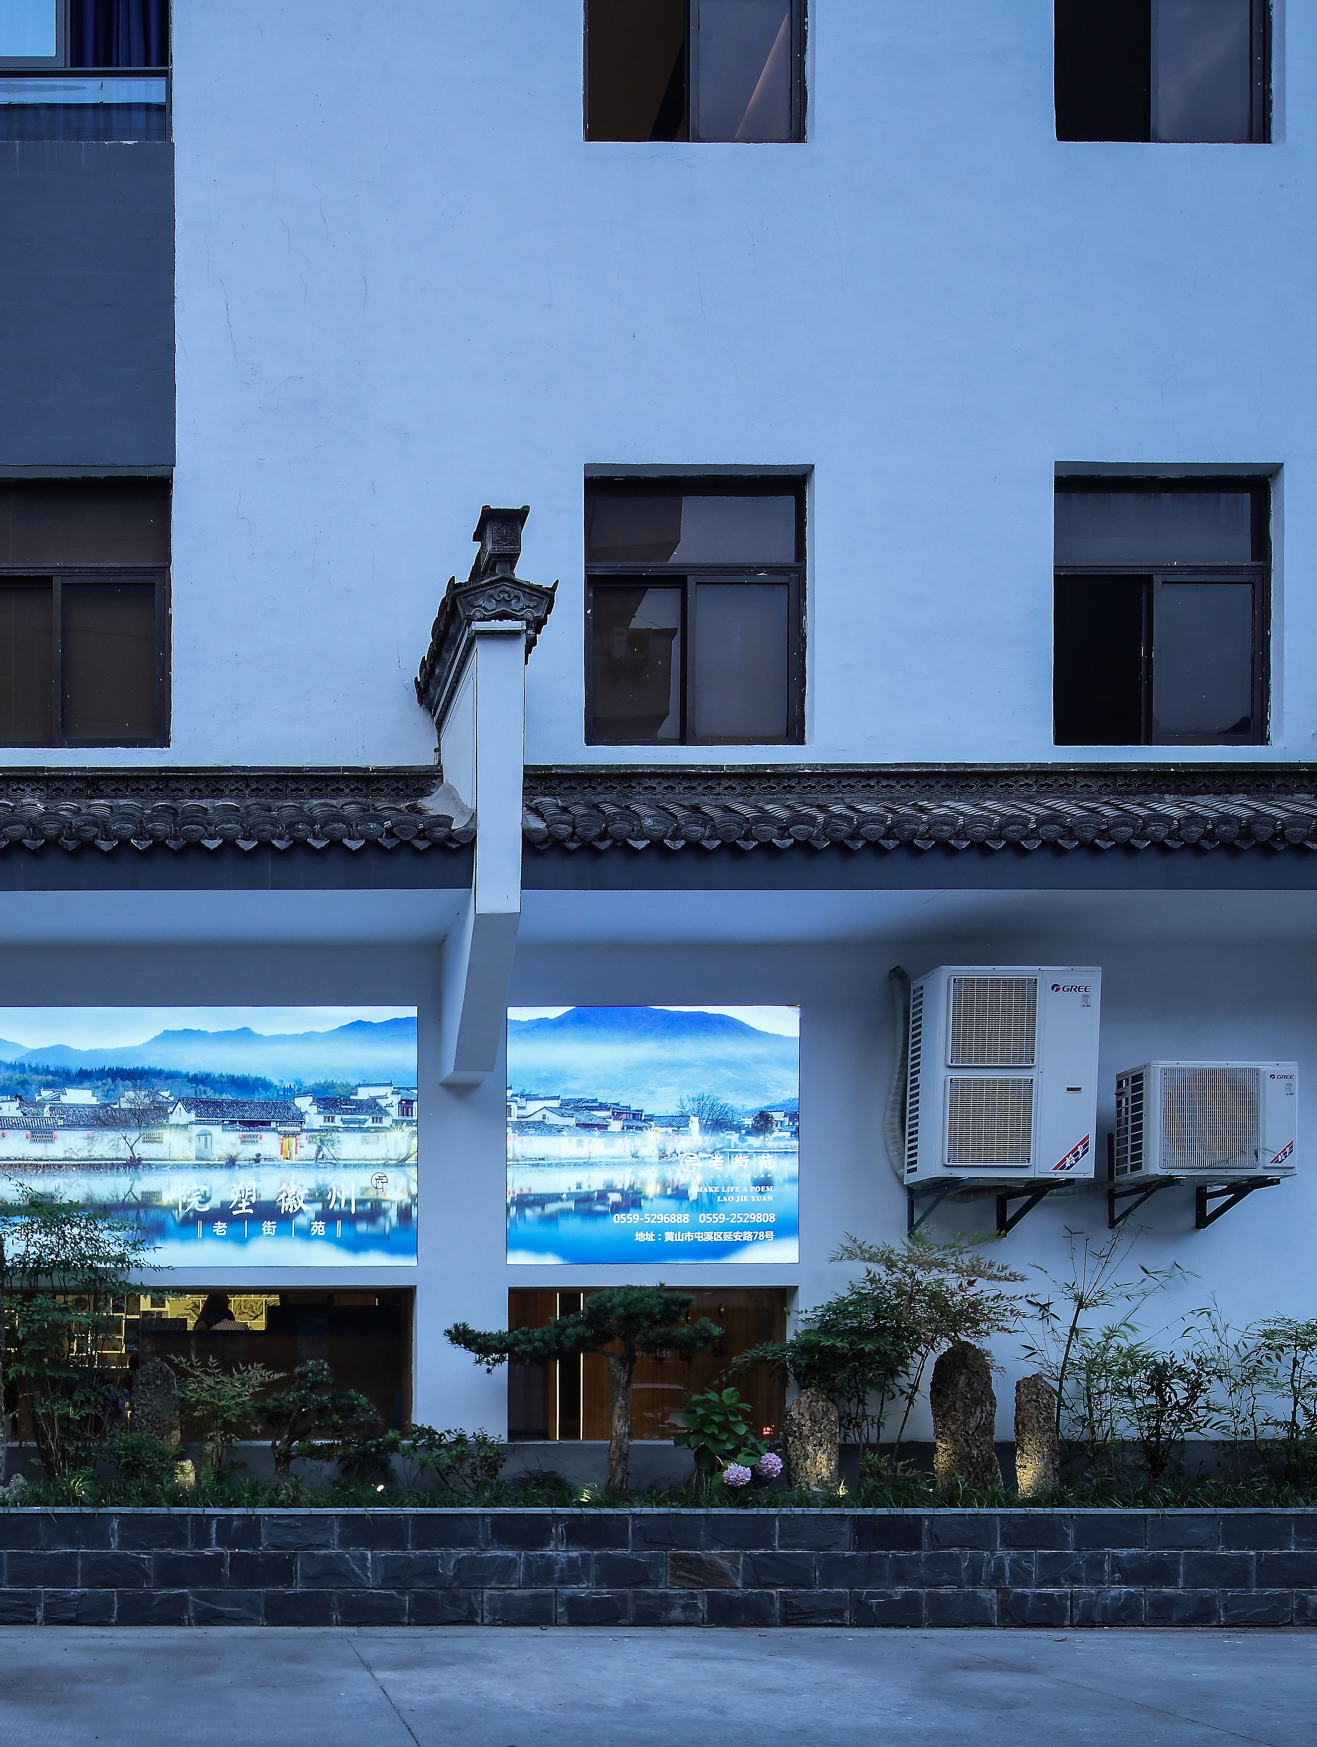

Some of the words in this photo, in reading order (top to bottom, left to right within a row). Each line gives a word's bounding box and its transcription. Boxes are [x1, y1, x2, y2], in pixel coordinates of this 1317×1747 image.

[1062, 984, 1091, 993] GREE
[709, 1154, 774, 1170] 老街苑
[736, 1195, 749, 1203] JIE
[613, 1213, 690, 1224] 0559-5296888
[699, 1212, 776, 1223] 0559-2529808
[212, 1220, 326, 1236] 老街苑
